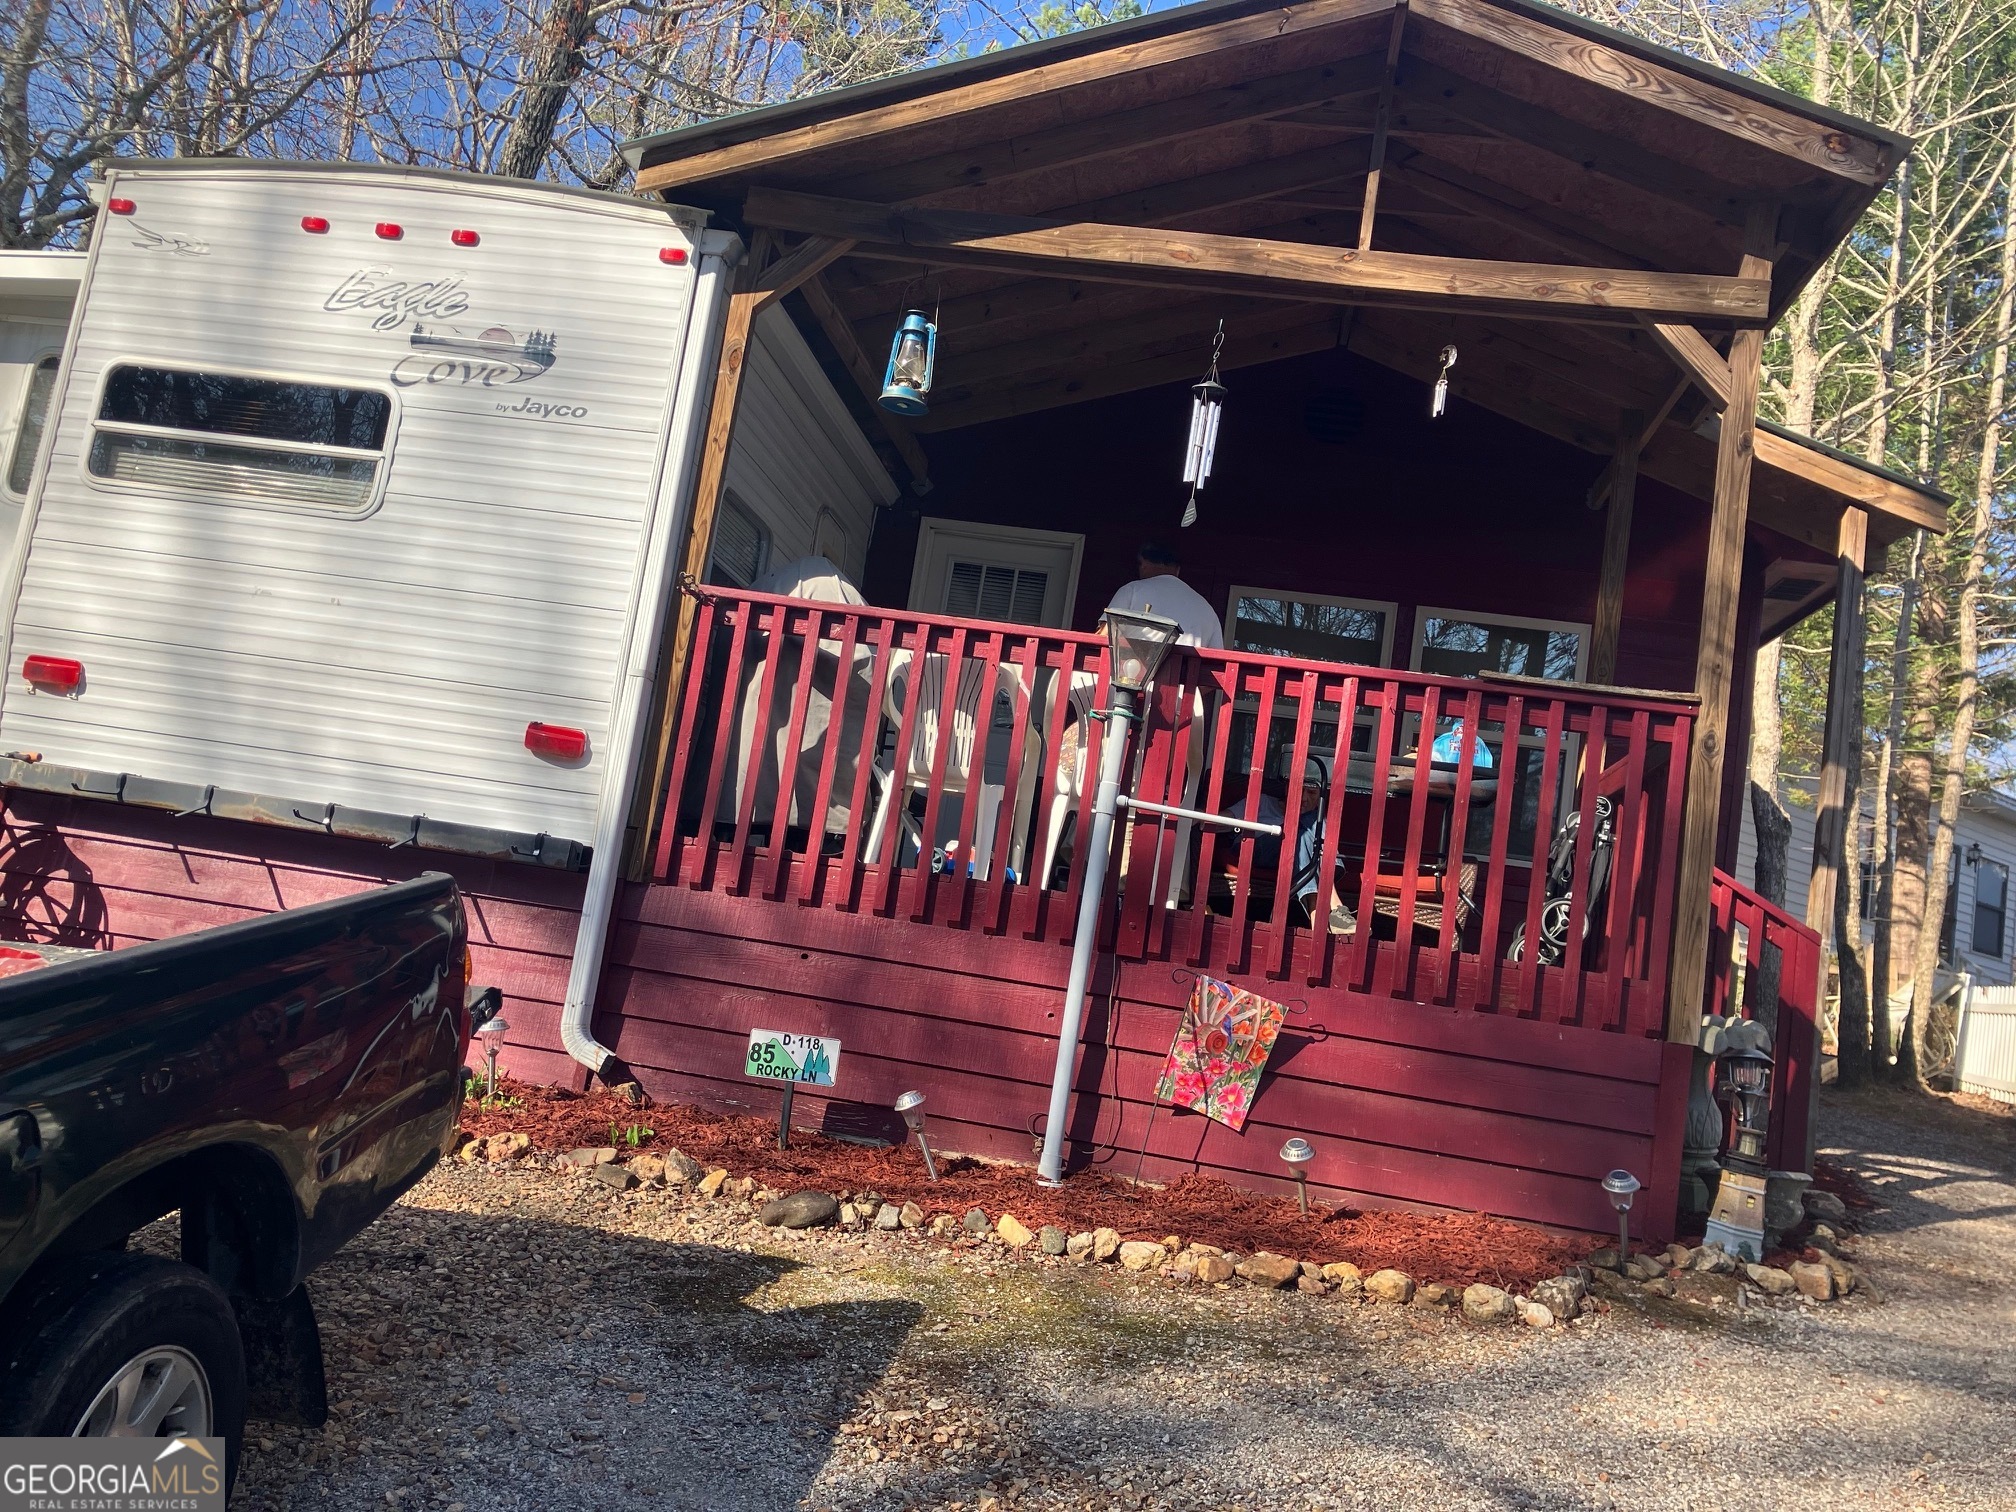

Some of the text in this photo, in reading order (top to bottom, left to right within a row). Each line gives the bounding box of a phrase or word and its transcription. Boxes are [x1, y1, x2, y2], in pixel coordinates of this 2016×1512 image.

[322, 264, 470, 332] Eagle
[390, 352, 509, 388] Cove
[495, 396, 589, 419] by Jayco
[750, 1042, 776, 1064] 85
[756, 1063, 818, 1083] ROCKY LN
